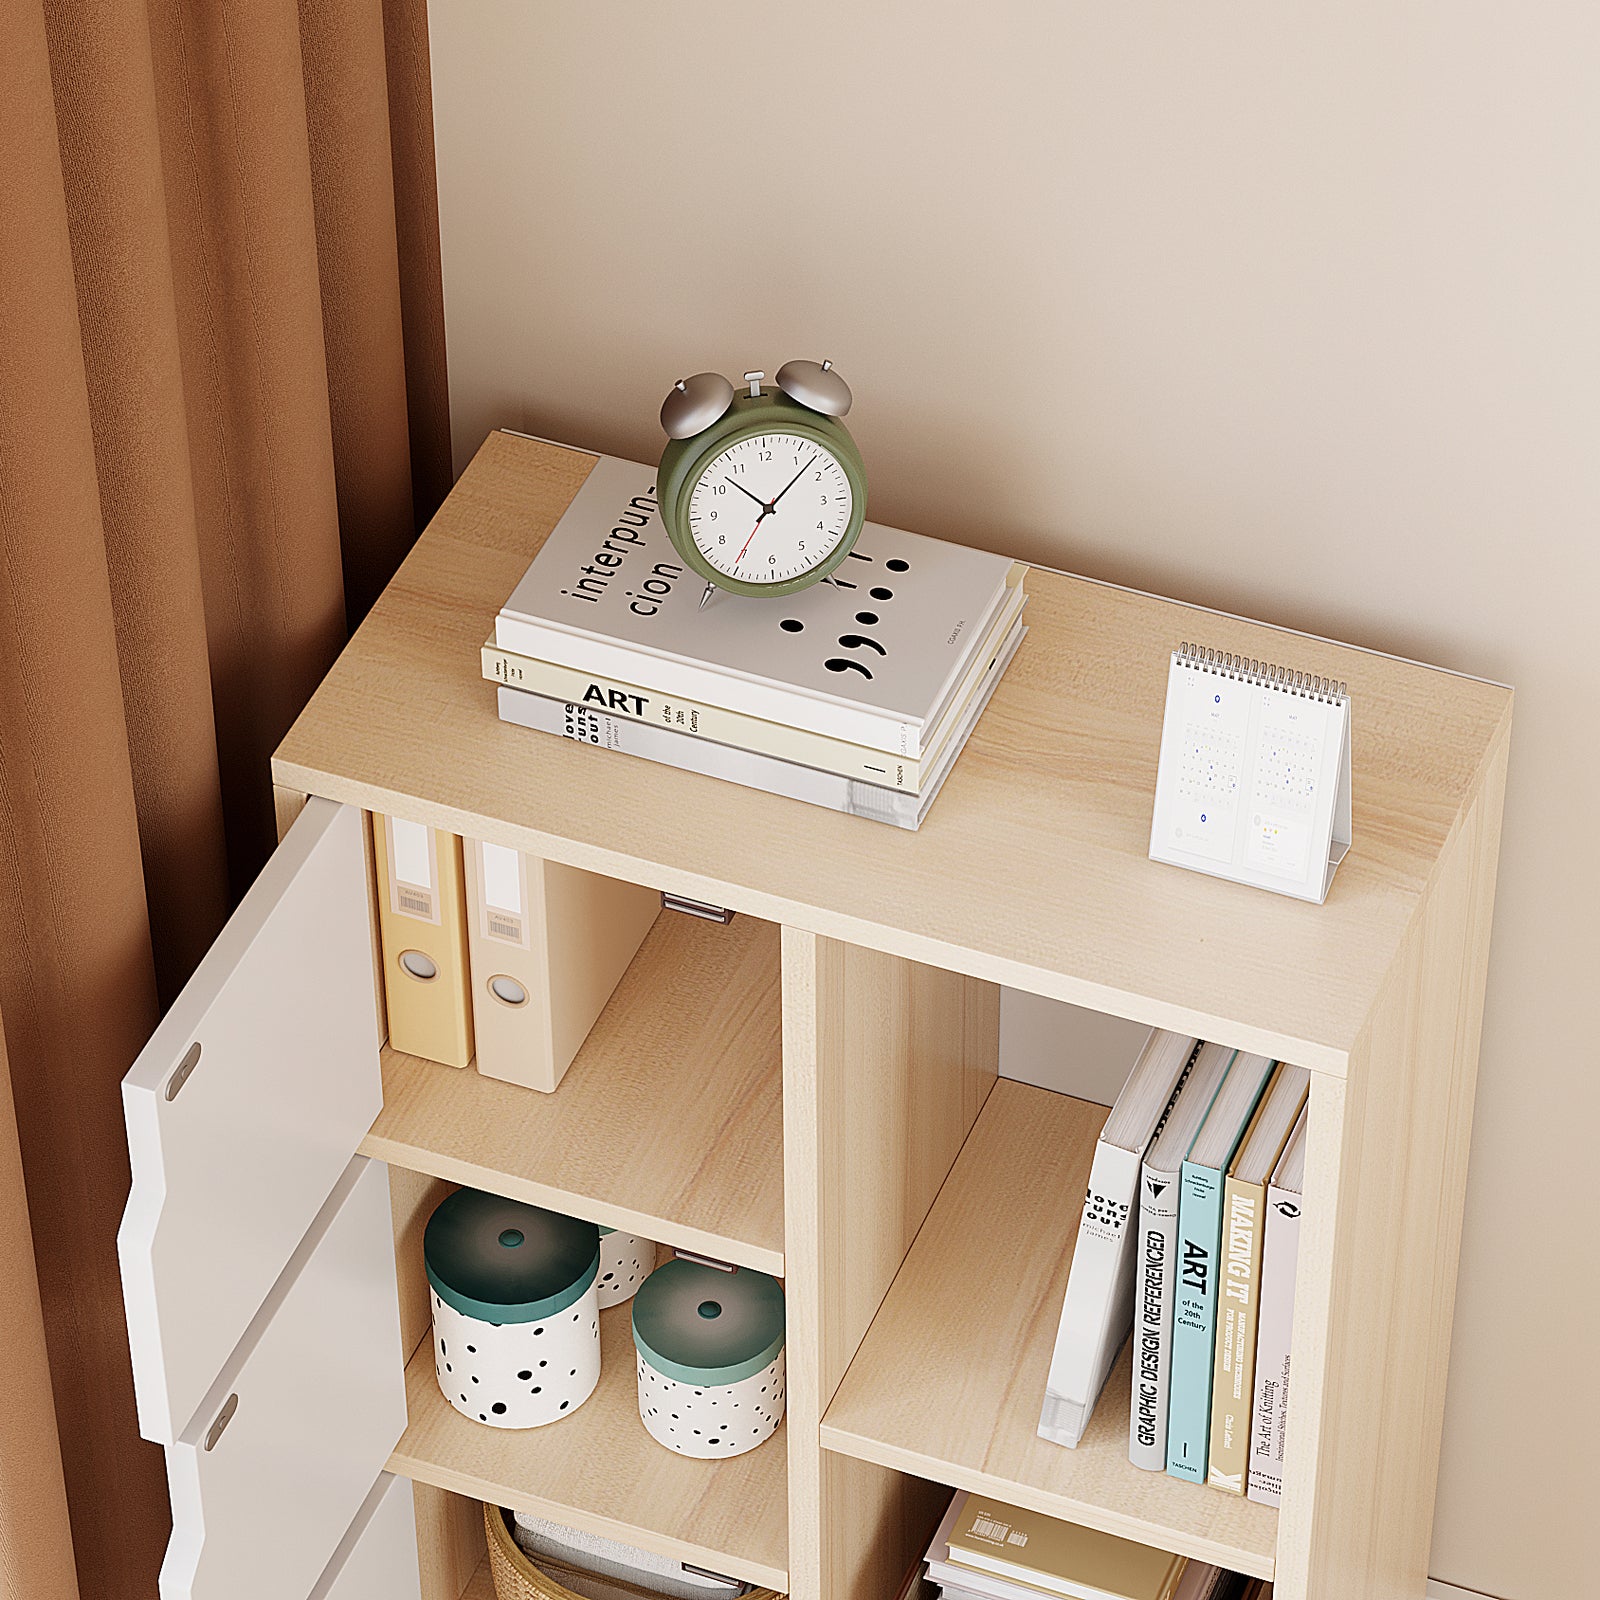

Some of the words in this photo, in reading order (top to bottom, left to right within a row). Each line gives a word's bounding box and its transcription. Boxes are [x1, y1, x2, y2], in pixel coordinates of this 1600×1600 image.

[758, 451, 773, 462] 12
[793, 456, 799, 466] 1
[732, 463, 746, 474] 11
[815, 471, 823, 482] 2
[712, 485, 727, 496] 10
[820, 495, 828, 506] 3
[710, 511, 718, 521] 9
[816, 521, 824, 530] 4
[560, 486, 658, 602] interpun-
[718, 535, 726, 545] 8
[798, 540, 806, 551] 5
[768, 554, 777, 565] 6
[625, 563, 683, 616] cion
[583, 684, 650, 716] ART
[563, 704, 575, 740] love
[689, 709, 700, 732] Century
[588, 714, 599, 744] out
[1085, 1188, 1129, 1211] love
[1087, 1211, 1121, 1229] out
[1082, 1223, 1121, 1239] michael
[1086, 1230, 1114, 1243] james
[1227, 1194, 1255, 1278] MAKING
[1182, 1239, 1208, 1295] ART
[1143, 1230, 1165, 1326] REFERENCED
[1226, 1279, 1249, 1304] IT
[1192, 1301, 1204, 1310] the
[1184, 1310, 1201, 1319] 20th
[1178, 1317, 1206, 1331] Century
[1140, 1327, 1160, 1381] DESIGN
[1282, 1376, 1290, 1387] and
[1259, 1379, 1279, 1414] Knitting
[1137, 1383, 1158, 1447] GRAPHIC
[1258, 1413, 1272, 1424] of
[1257, 1425, 1272, 1441] Art
[1256, 1441, 1270, 1457] The
[1172, 1461, 1197, 1473] TASCHEN
